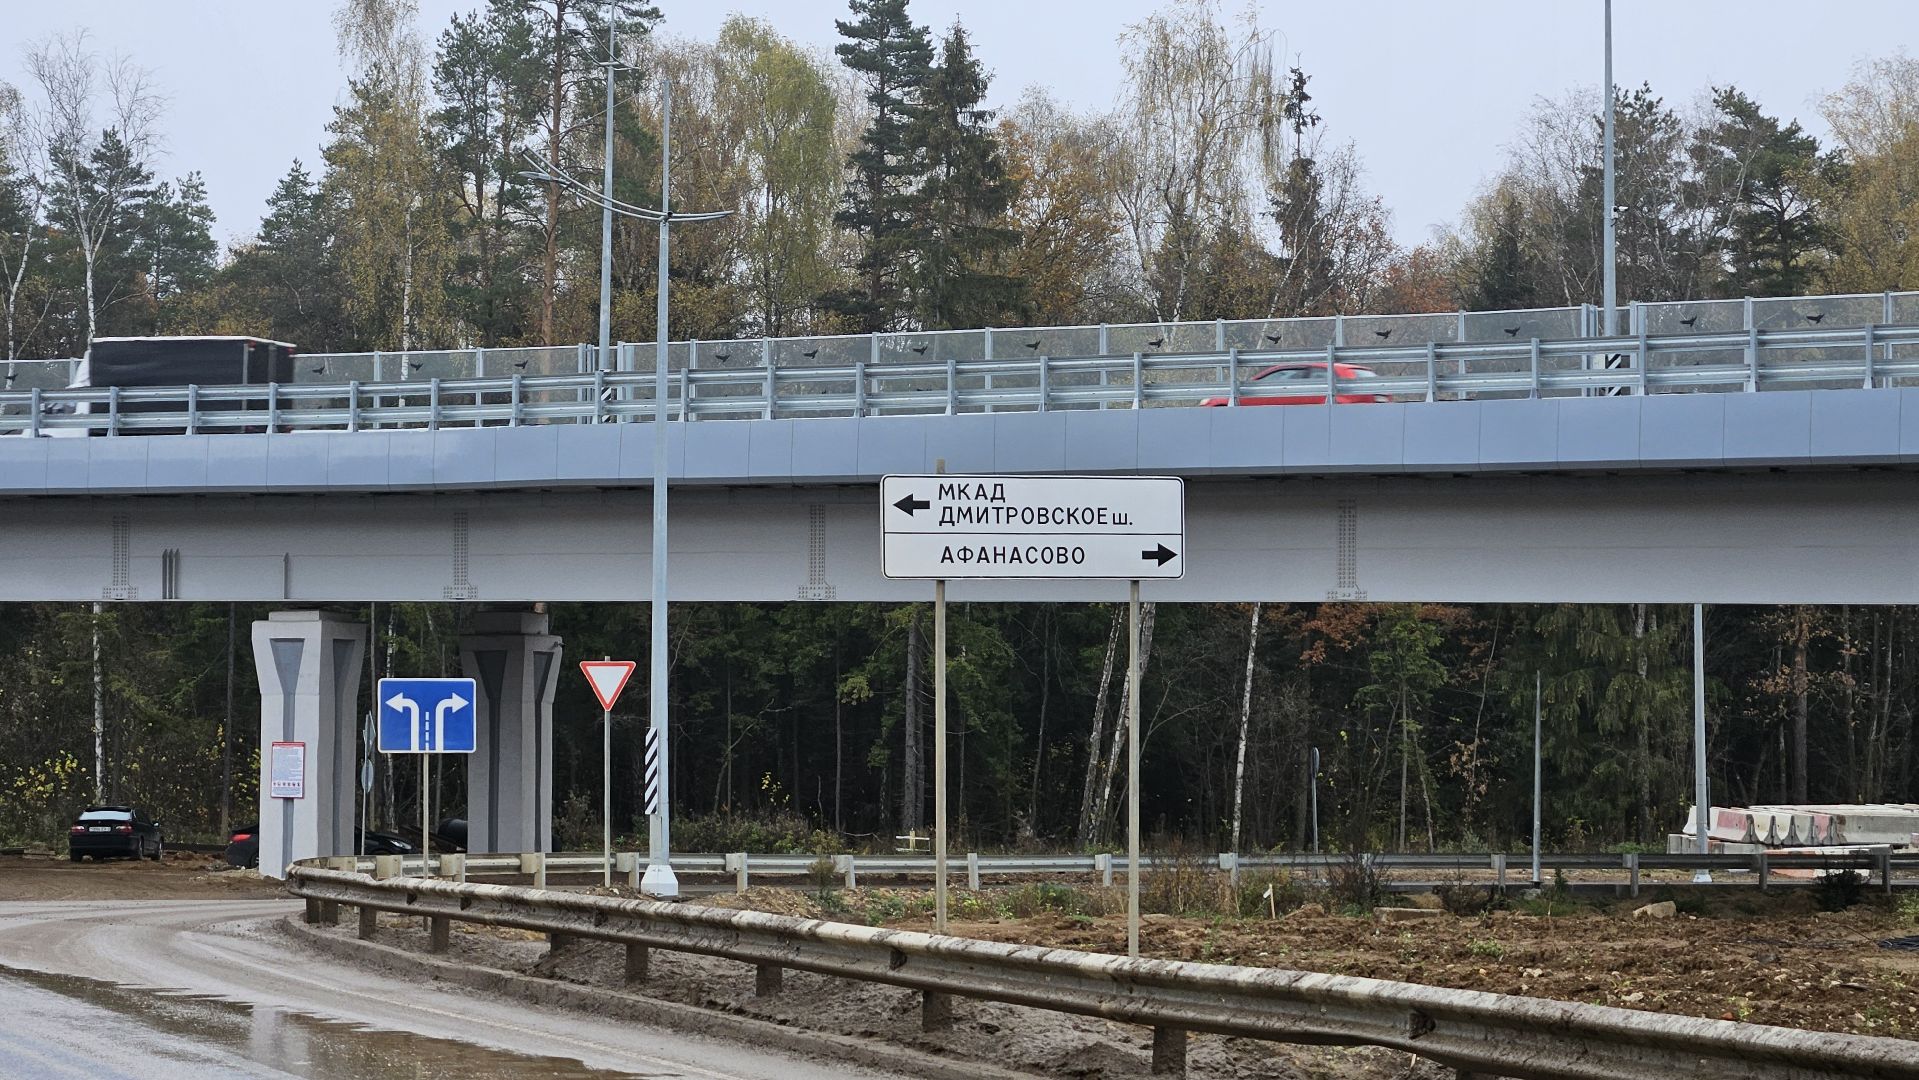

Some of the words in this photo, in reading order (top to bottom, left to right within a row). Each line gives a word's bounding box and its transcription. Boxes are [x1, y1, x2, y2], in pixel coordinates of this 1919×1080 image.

[938, 483, 1006, 503] МКАД
[939, 506, 1108, 527] ДМИТРОВСКОЕ
[1112, 512, 1134, 526] ш.
[940, 545, 1085, 565] АФАНАСОВО
